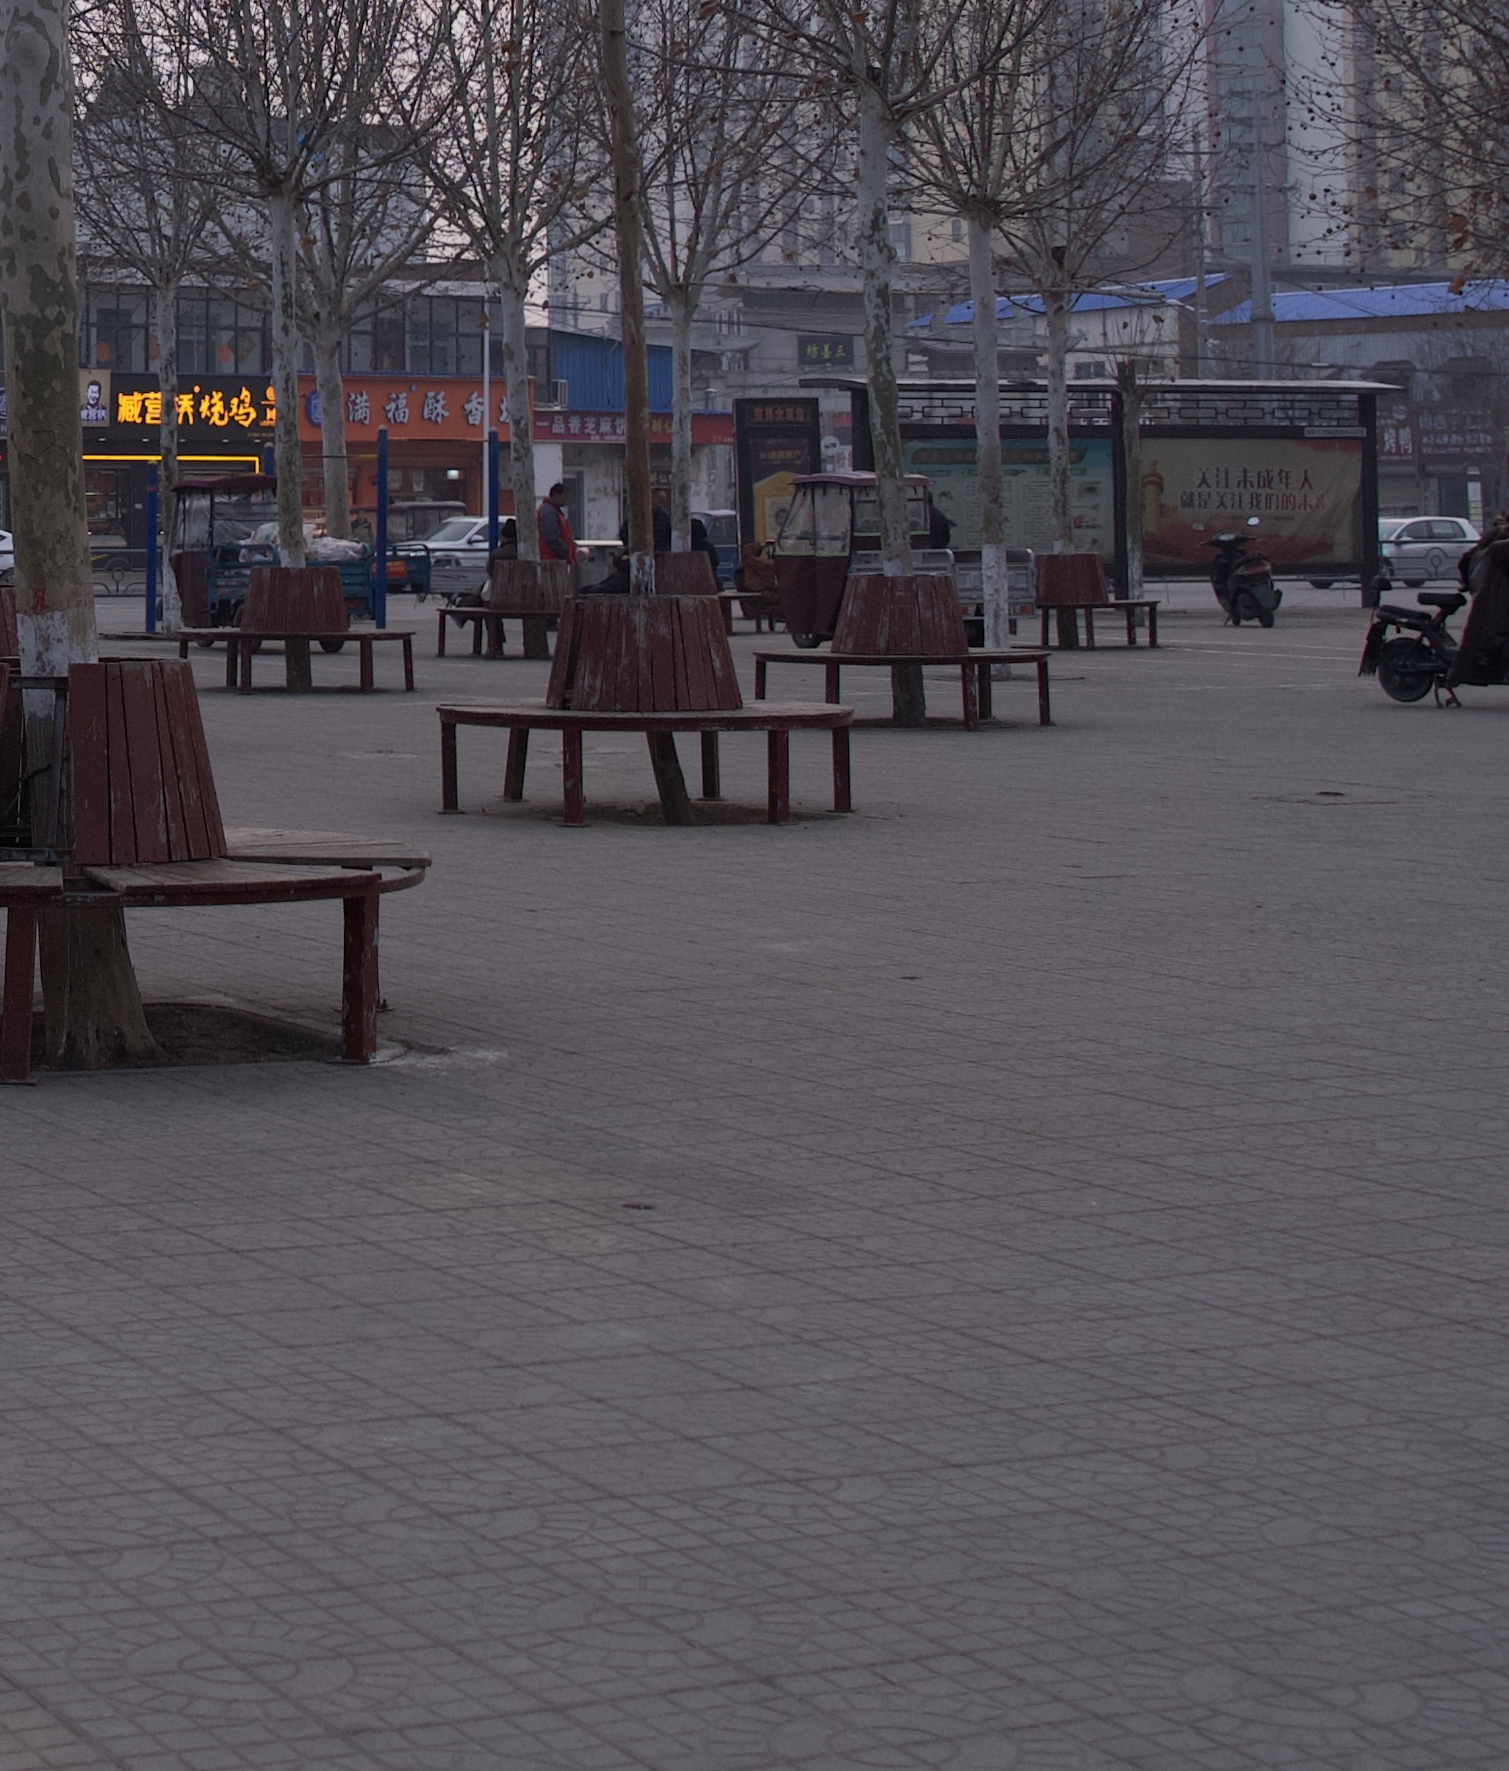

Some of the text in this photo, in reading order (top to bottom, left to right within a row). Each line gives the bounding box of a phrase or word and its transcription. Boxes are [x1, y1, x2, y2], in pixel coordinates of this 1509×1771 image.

[1195, 467, 1315, 491] 关注未成年人
